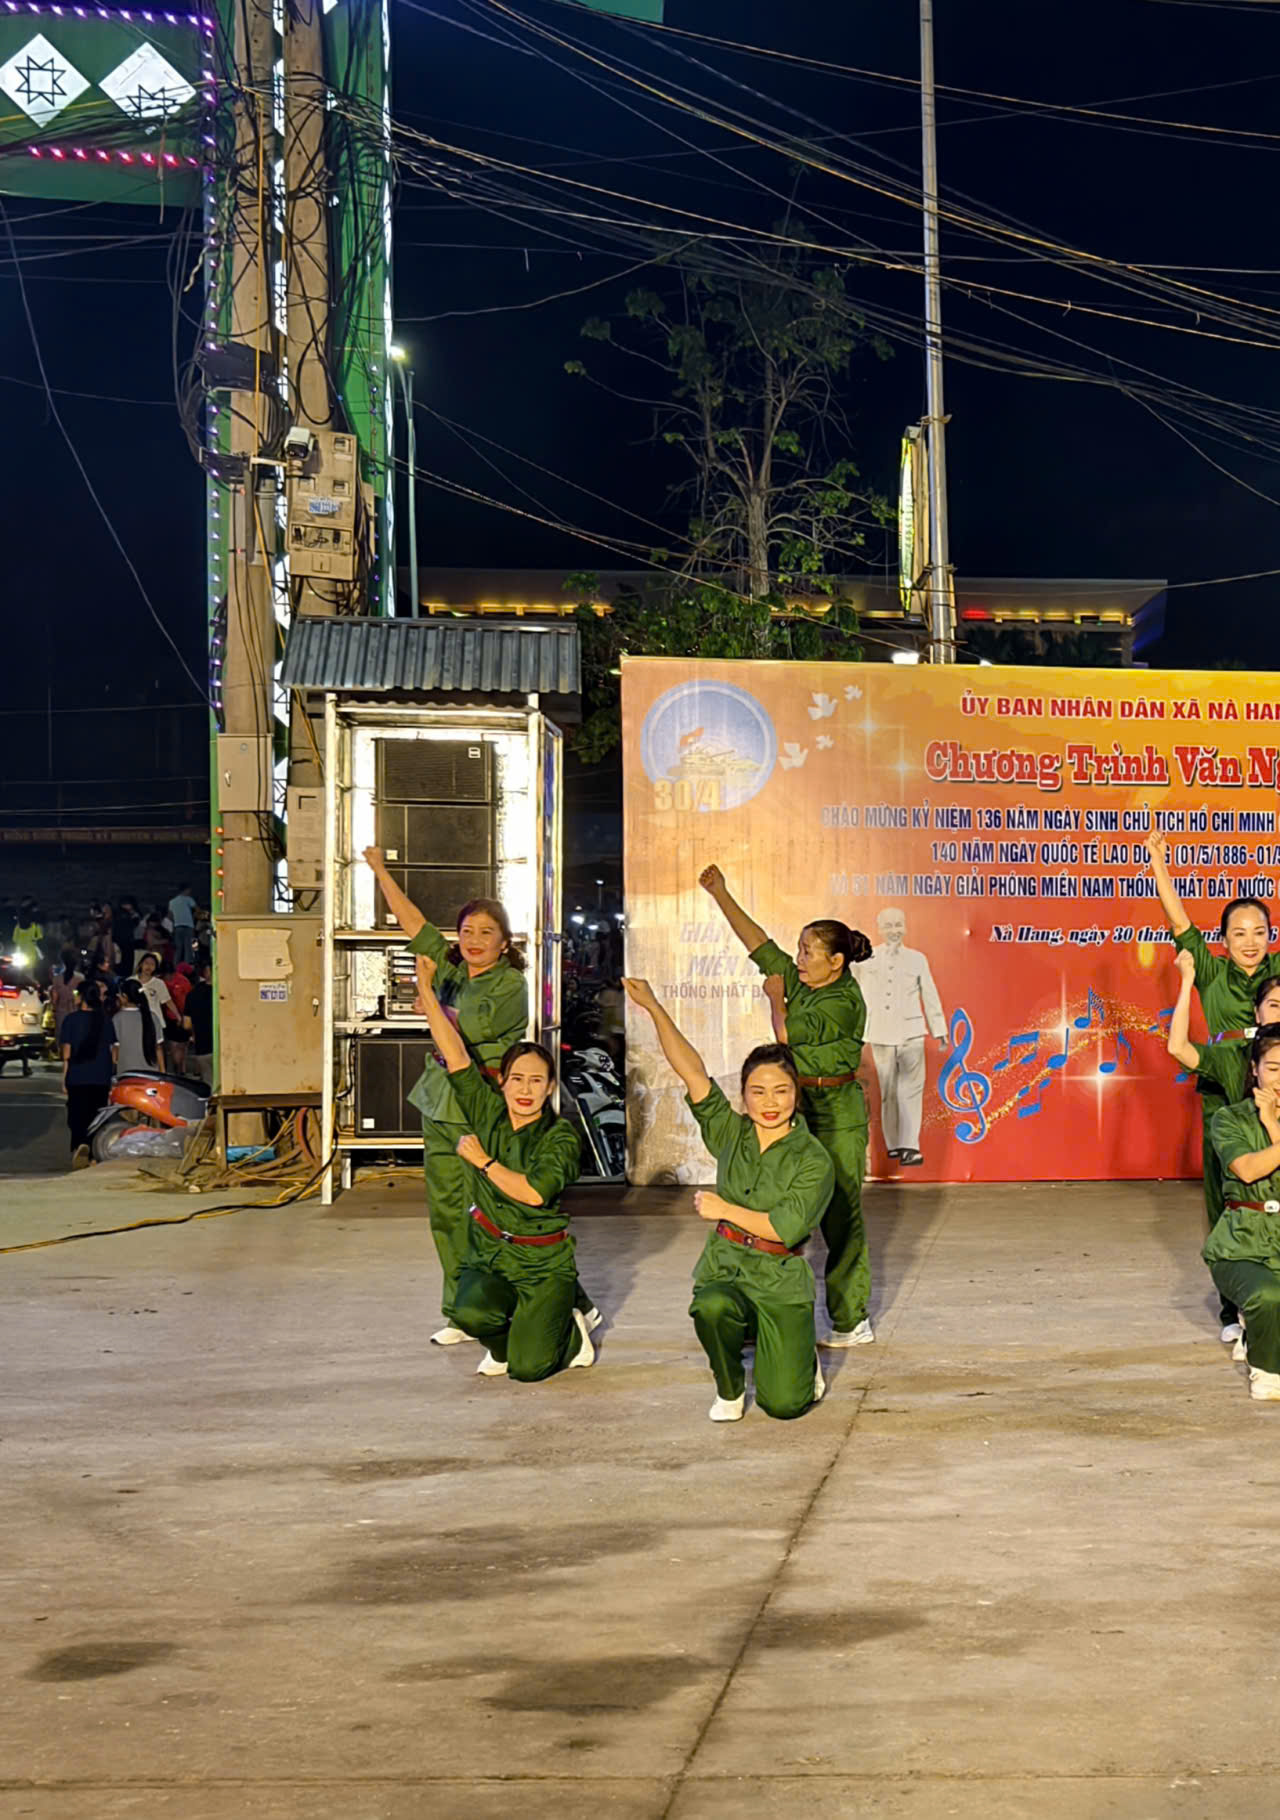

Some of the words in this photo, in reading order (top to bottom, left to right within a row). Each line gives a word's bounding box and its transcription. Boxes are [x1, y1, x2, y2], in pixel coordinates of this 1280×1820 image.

[961, 689, 989, 716] ỦY
[997, 696, 1043, 717] BAN
[1051, 696, 1112, 718] NHÂN
[1120, 696, 1166, 720] DÂN
[1173, 697, 1201, 720] XÃ
[1208, 698, 1239, 721] NÀ
[925, 740, 1062, 790] Chương
[1067, 741, 1169, 785] Trình
[1174, 744, 1242, 785] Văn
[654, 779, 721, 811] 30/4
[864, 802, 908, 829] MỪNG
[912, 799, 930, 829] KỶ
[935, 804, 972, 833] NIỆM
[976, 808, 1001, 829] 136
[1005, 804, 1039, 830] NĂM
[1043, 805, 1080, 831] NGÀY
[1085, 809, 1119, 832] SINH
[1122, 803, 1150, 832] CHỦ
[1155, 811, 1184, 836] TỊCH
[1189, 802, 1208, 832] HỒ
[1212, 806, 1234, 833] CHÍ
[1239, 811, 1275, 833] MINH
[931, 841, 957, 862] 140
[962, 838, 994, 863] NĂM
[999, 838, 1037, 863] NGÀY
[1041, 836, 1078, 866] QUỐC
[1082, 836, 1099, 863] TẾ
[1103, 844, 1128, 865] LAO
[913, 870, 952, 897] NGÀY
[956, 867, 985, 897] GIẢI
[989, 870, 1037, 898] PHÓNG
[1041, 869, 1078, 898] MIỀN
[1082, 877, 1115, 898] NAM
[1208, 871, 1233, 899] ĐẤT
[1238, 872, 1275, 899] NƯỚC
[990, 924, 1013, 942] Nà
[1068, 924, 1110, 946] ngày
[1112, 926, 1134, 943] 30
[1136, 925, 1175, 945] thán
[1201, 927, 1223, 943] nă
[663, 979, 706, 999] THỐNG
